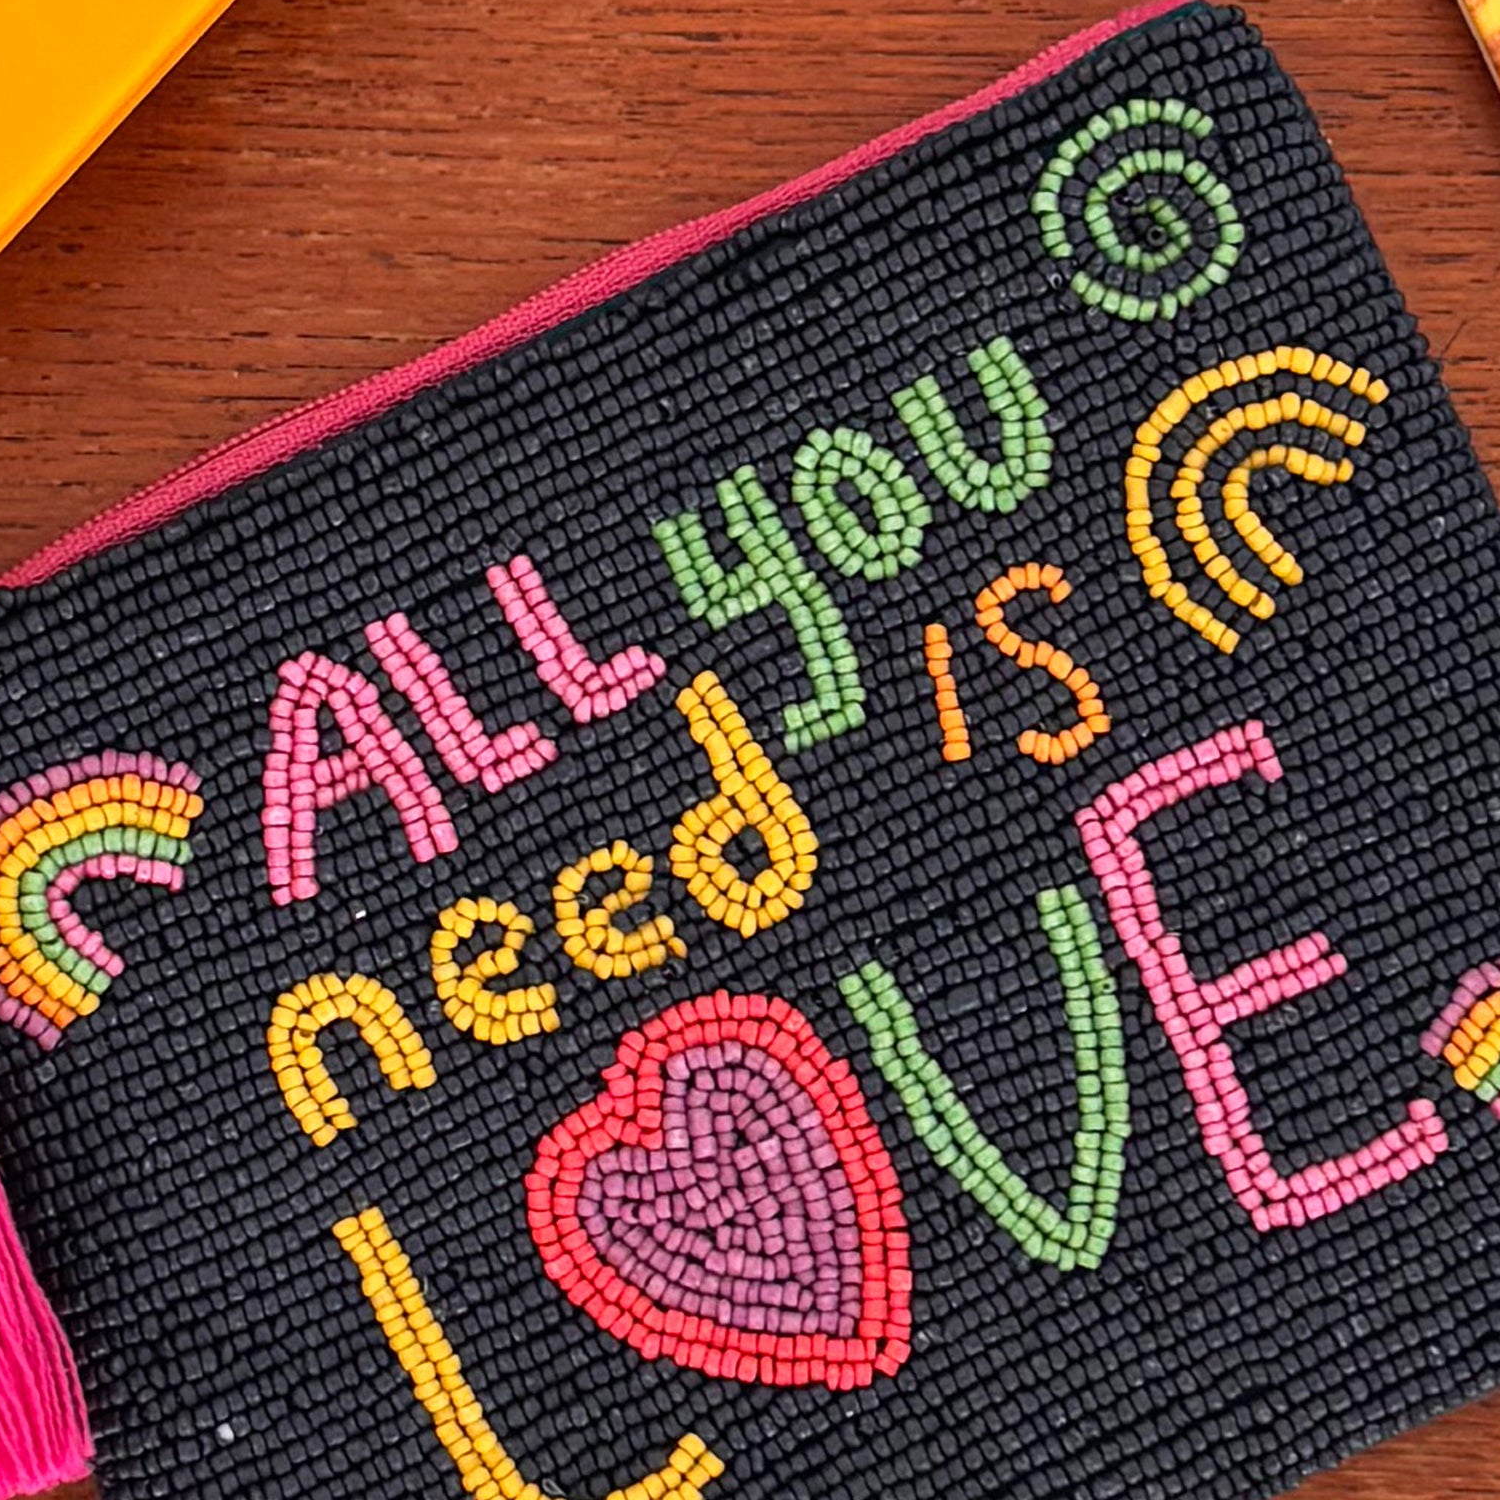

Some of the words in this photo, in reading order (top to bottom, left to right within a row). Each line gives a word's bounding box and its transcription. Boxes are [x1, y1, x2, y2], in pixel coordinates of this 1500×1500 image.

[263, 556, 666, 906] ALL
[653, 336, 1052, 754] you
[267, 670, 819, 1147] need
